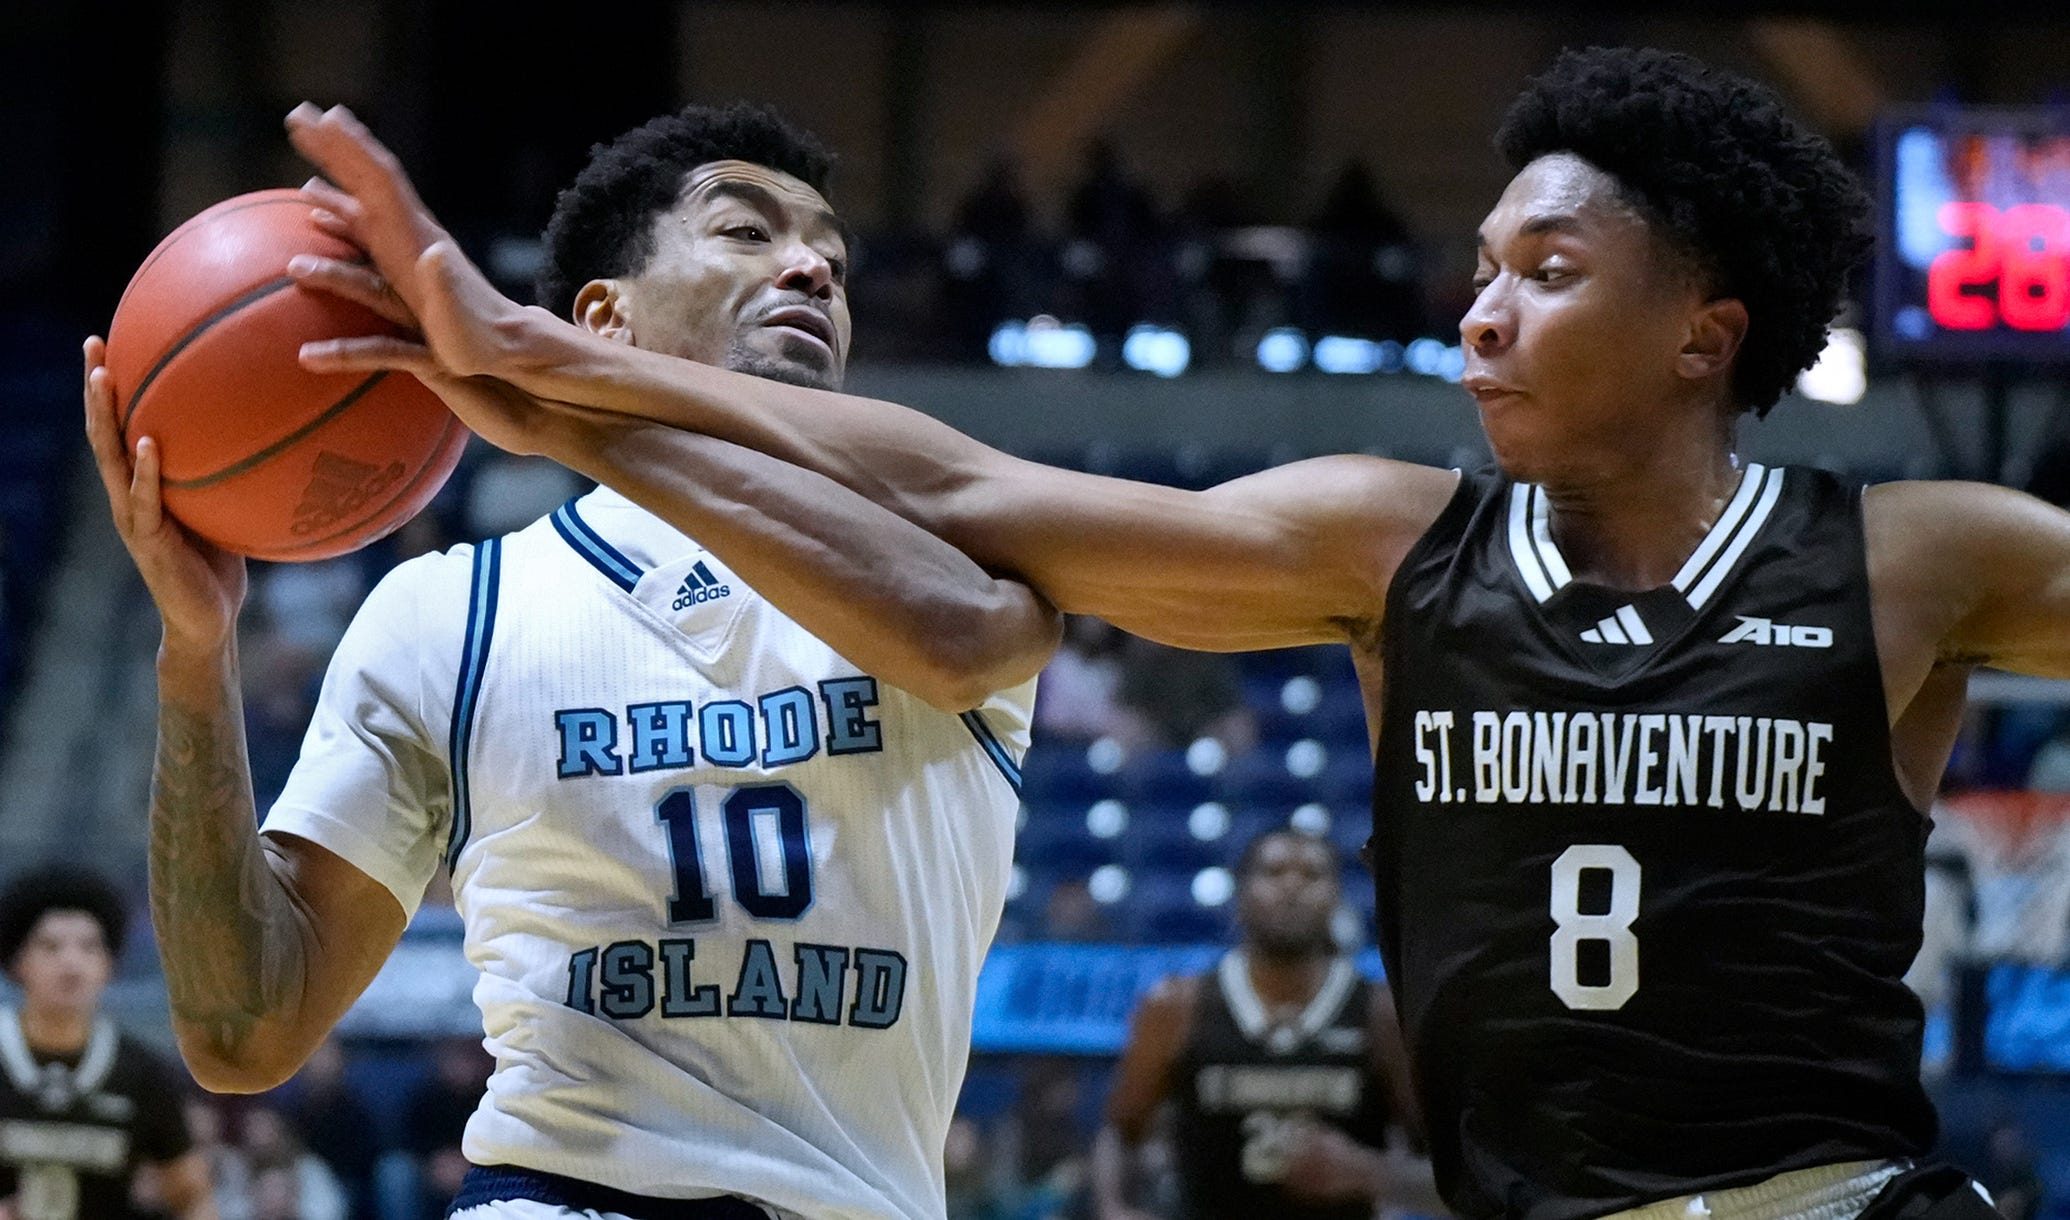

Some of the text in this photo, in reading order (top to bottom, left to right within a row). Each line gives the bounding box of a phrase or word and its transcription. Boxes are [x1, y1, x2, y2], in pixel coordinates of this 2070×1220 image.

[672, 585, 730, 611] adidas
[1717, 615, 1834, 648] A10
[554, 676, 883, 779] RHODE
[1414, 710, 1834, 815] ST. BONAVENTURE
[652, 779, 816, 931] 10
[1550, 844, 1642, 1010] 8
[563, 938, 908, 1030] ISLAND
